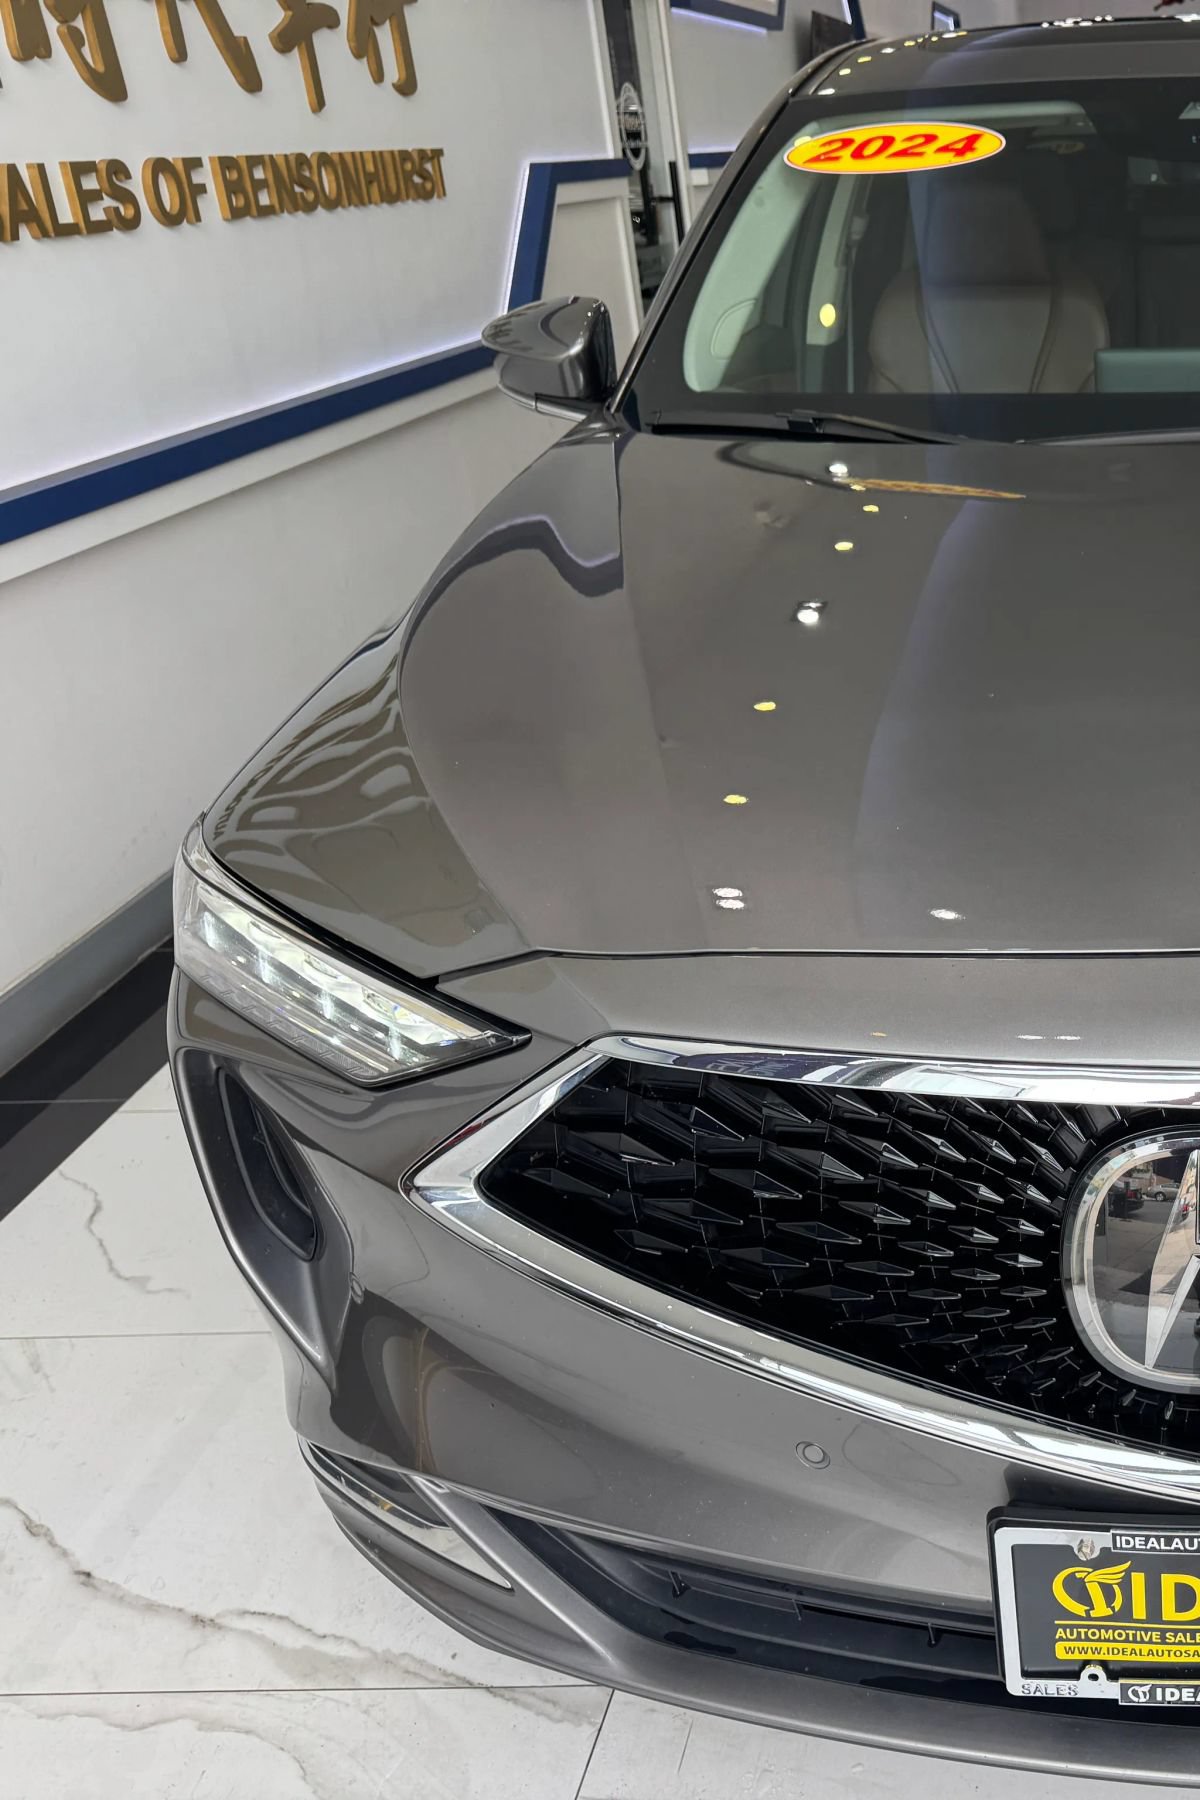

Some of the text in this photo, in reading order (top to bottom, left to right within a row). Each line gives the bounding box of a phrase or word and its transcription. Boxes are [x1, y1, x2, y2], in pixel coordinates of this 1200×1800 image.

[803, 133, 985, 164] 2024
[0, 148, 447, 242] ALES OF BENSONHURST
[1055, 1628, 1162, 1643] AUTOMOTIVE
[1021, 1683, 1079, 1697] SALES
